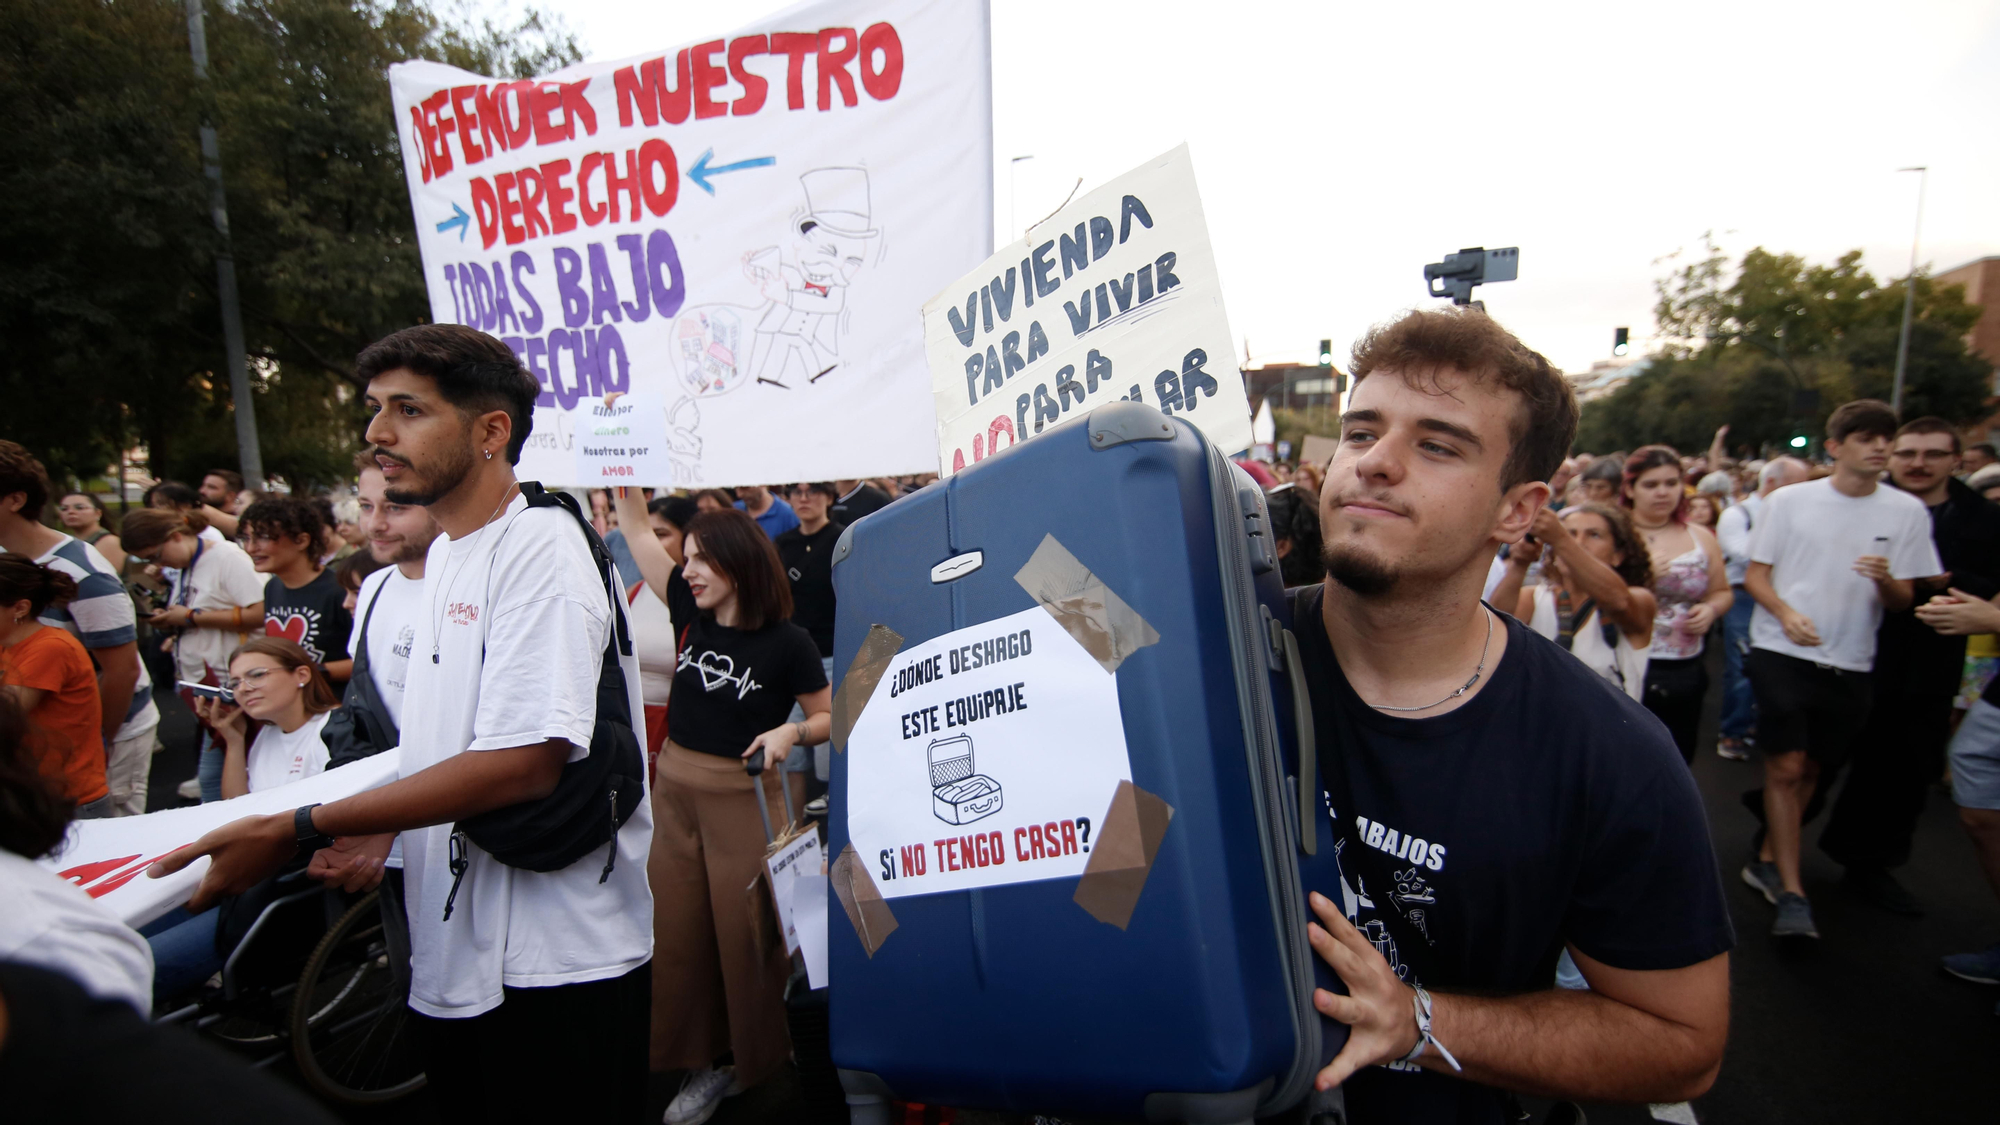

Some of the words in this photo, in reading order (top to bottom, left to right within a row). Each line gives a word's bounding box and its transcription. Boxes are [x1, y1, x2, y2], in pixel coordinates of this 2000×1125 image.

[410, 78, 597, 183] DEFENDER
[613, 21, 904, 127] NUESTRO
[470, 138, 680, 250] DERECHO
[444, 250, 543, 336] TODAS
[553, 229, 686, 327] BAJO
[947, 194, 1154, 348] VIVIENDA
[964, 320, 1050, 406] PARA
[1063, 251, 1181, 336] VIVIR
[1016, 348, 1113, 441] PARA
[583, 445, 626, 457] Nosotras
[629, 446, 649, 458] por
[602, 465, 634, 477] AMOR
[891, 654, 944, 698] ¿DÓNDE
[949, 629, 1032, 675] DESHAGO
[901, 706, 940, 740] ESTE
[901, 845, 926, 877] NO
[934, 830, 1005, 873] TENGO
[1013, 817, 1091, 862] CASA?
